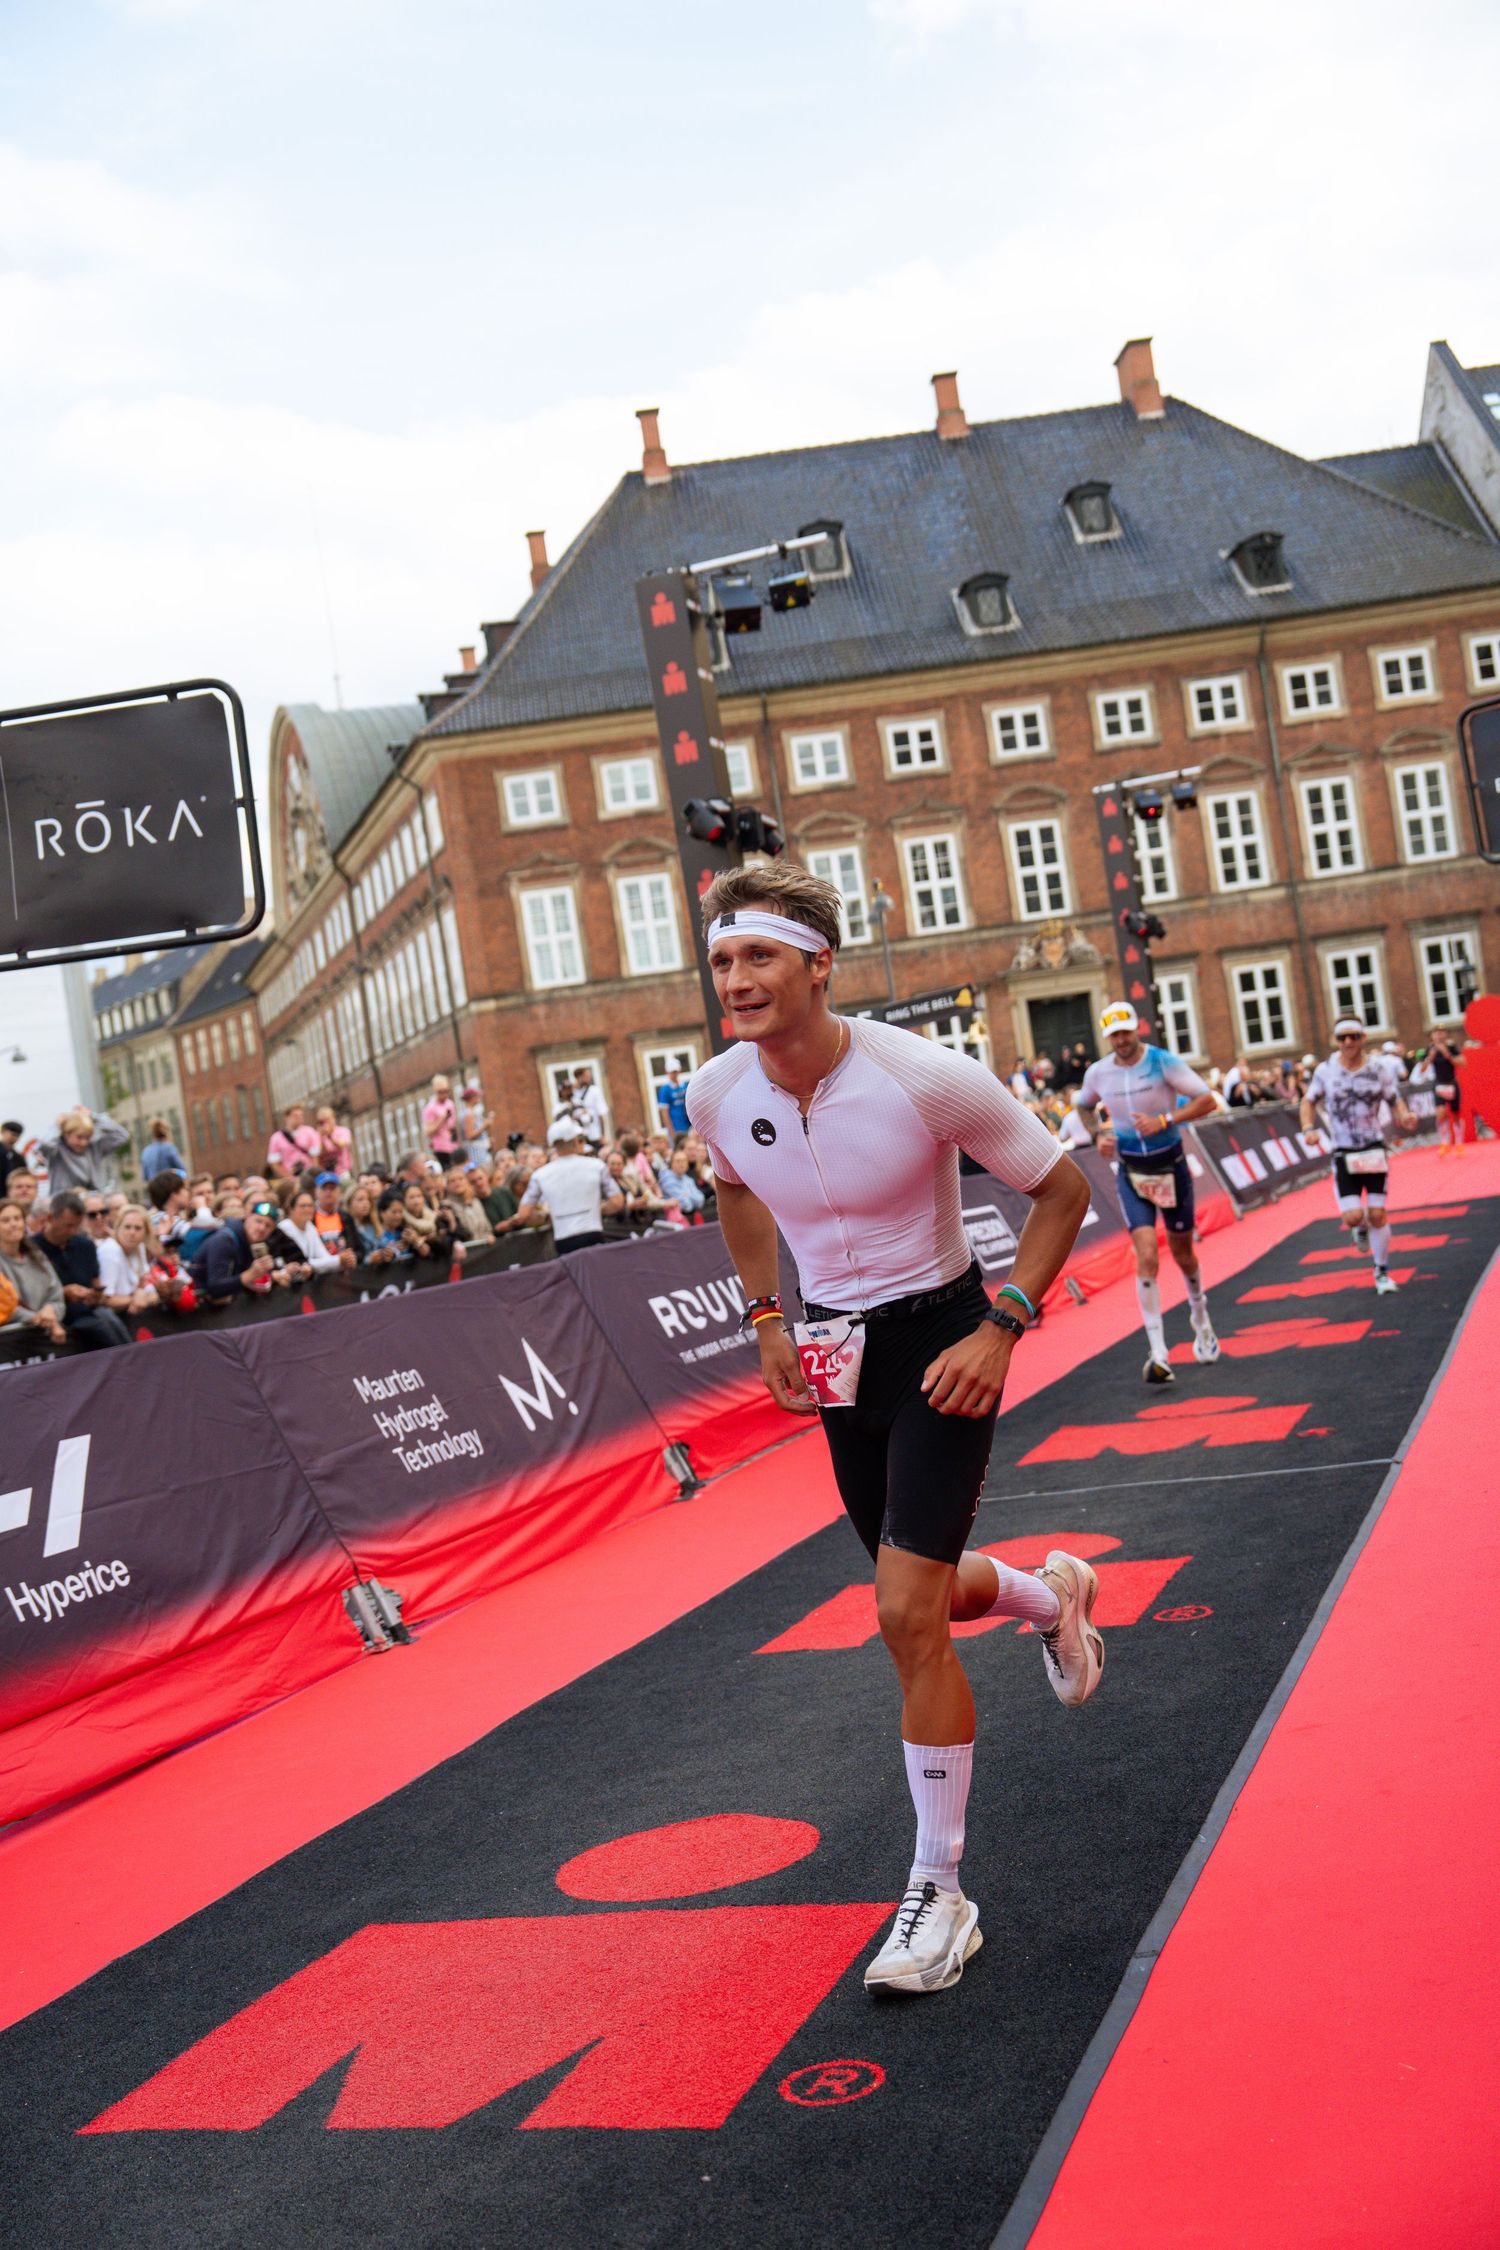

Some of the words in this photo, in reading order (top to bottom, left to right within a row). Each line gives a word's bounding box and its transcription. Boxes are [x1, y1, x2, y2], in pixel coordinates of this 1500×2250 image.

[885, 1006, 911, 1022] RING
[911, 1001, 930, 1016] THE
[931, 996, 955, 1012] BELL
[647, 1274, 746, 1339] ROUV
[352, 1368, 425, 1404] Maurten
[372, 1393, 449, 1442] Hydrogel
[391, 1428, 484, 1474] Technology
[4, 1559, 131, 1623] Hyperice
